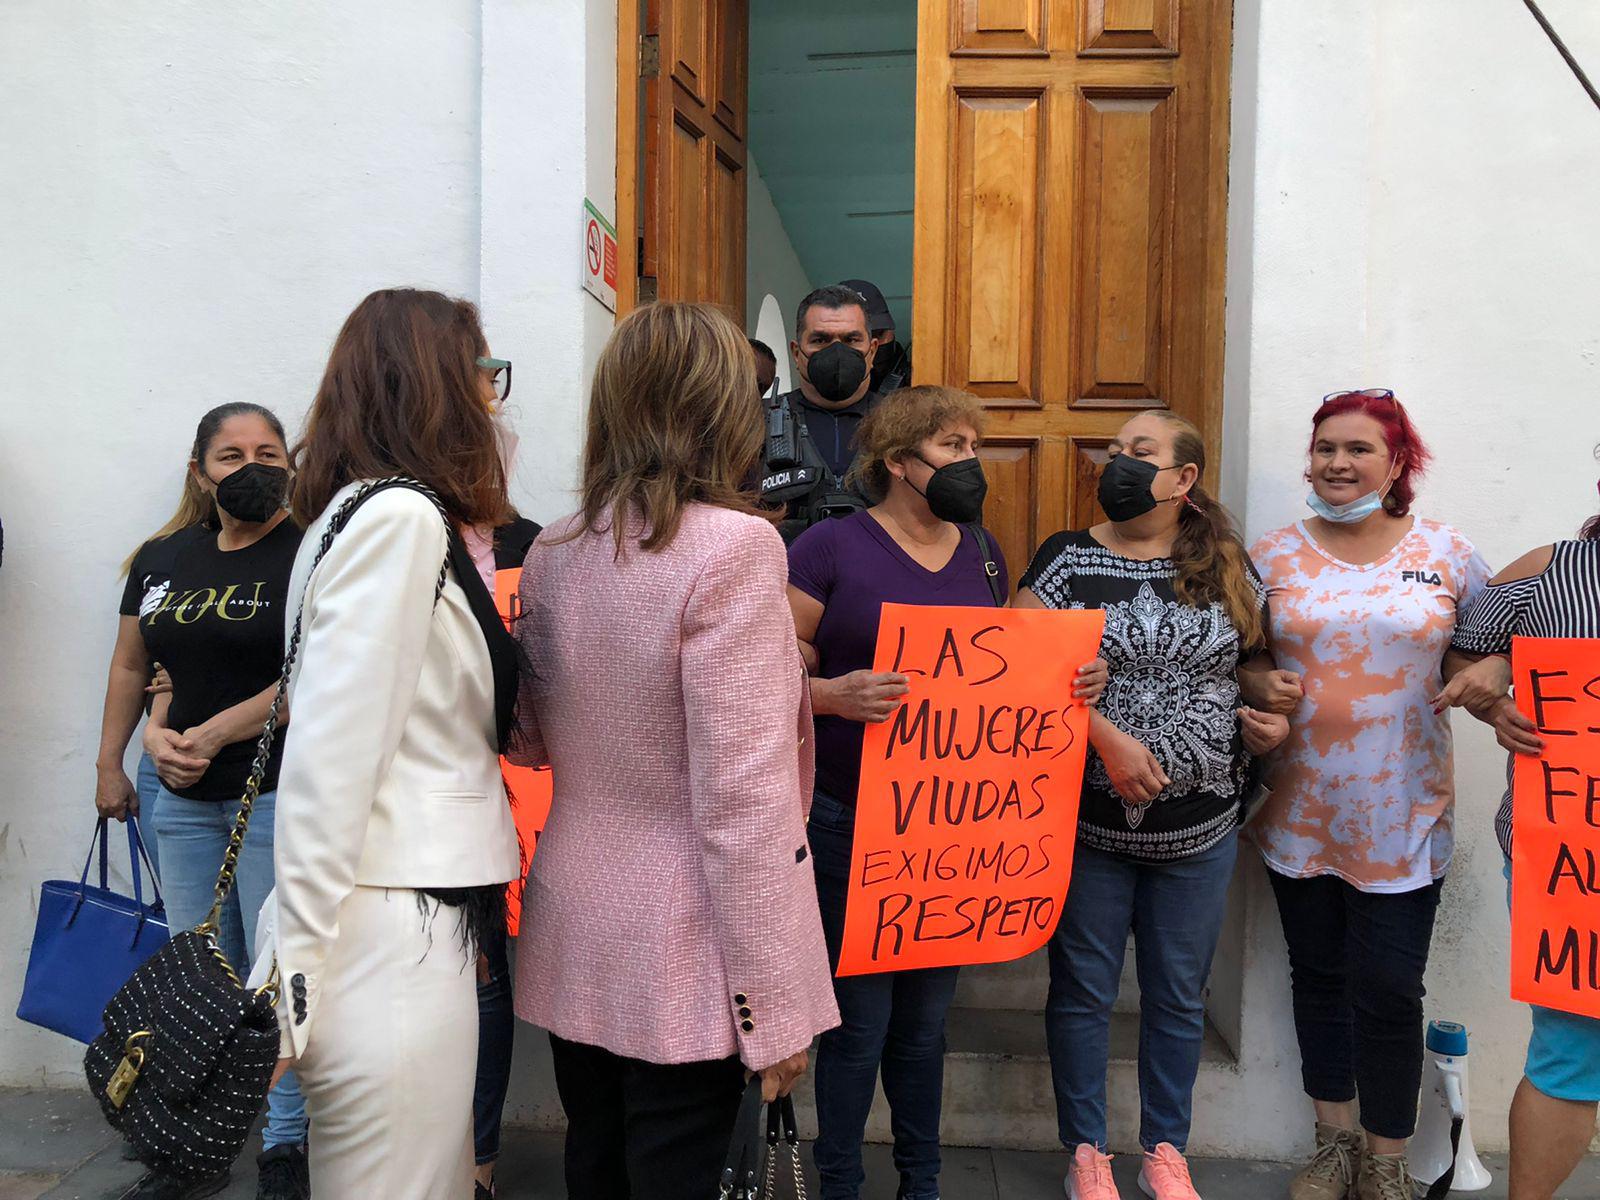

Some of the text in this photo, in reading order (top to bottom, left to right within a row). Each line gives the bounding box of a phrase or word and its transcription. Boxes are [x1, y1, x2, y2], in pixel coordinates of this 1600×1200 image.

[761, 472, 791, 491] POLICIA
[147, 581, 267, 625] YOU
[229, 599, 271, 607] ABOUT
[1402, 571, 1442, 586] FILA
[893, 626, 1008, 686] LAS
[885, 699, 1074, 760] MUJERES
[891, 774, 1049, 835] VIUDAS
[862, 834, 1053, 887] EXIGIMOS
[871, 893, 1054, 961] RESPETO
